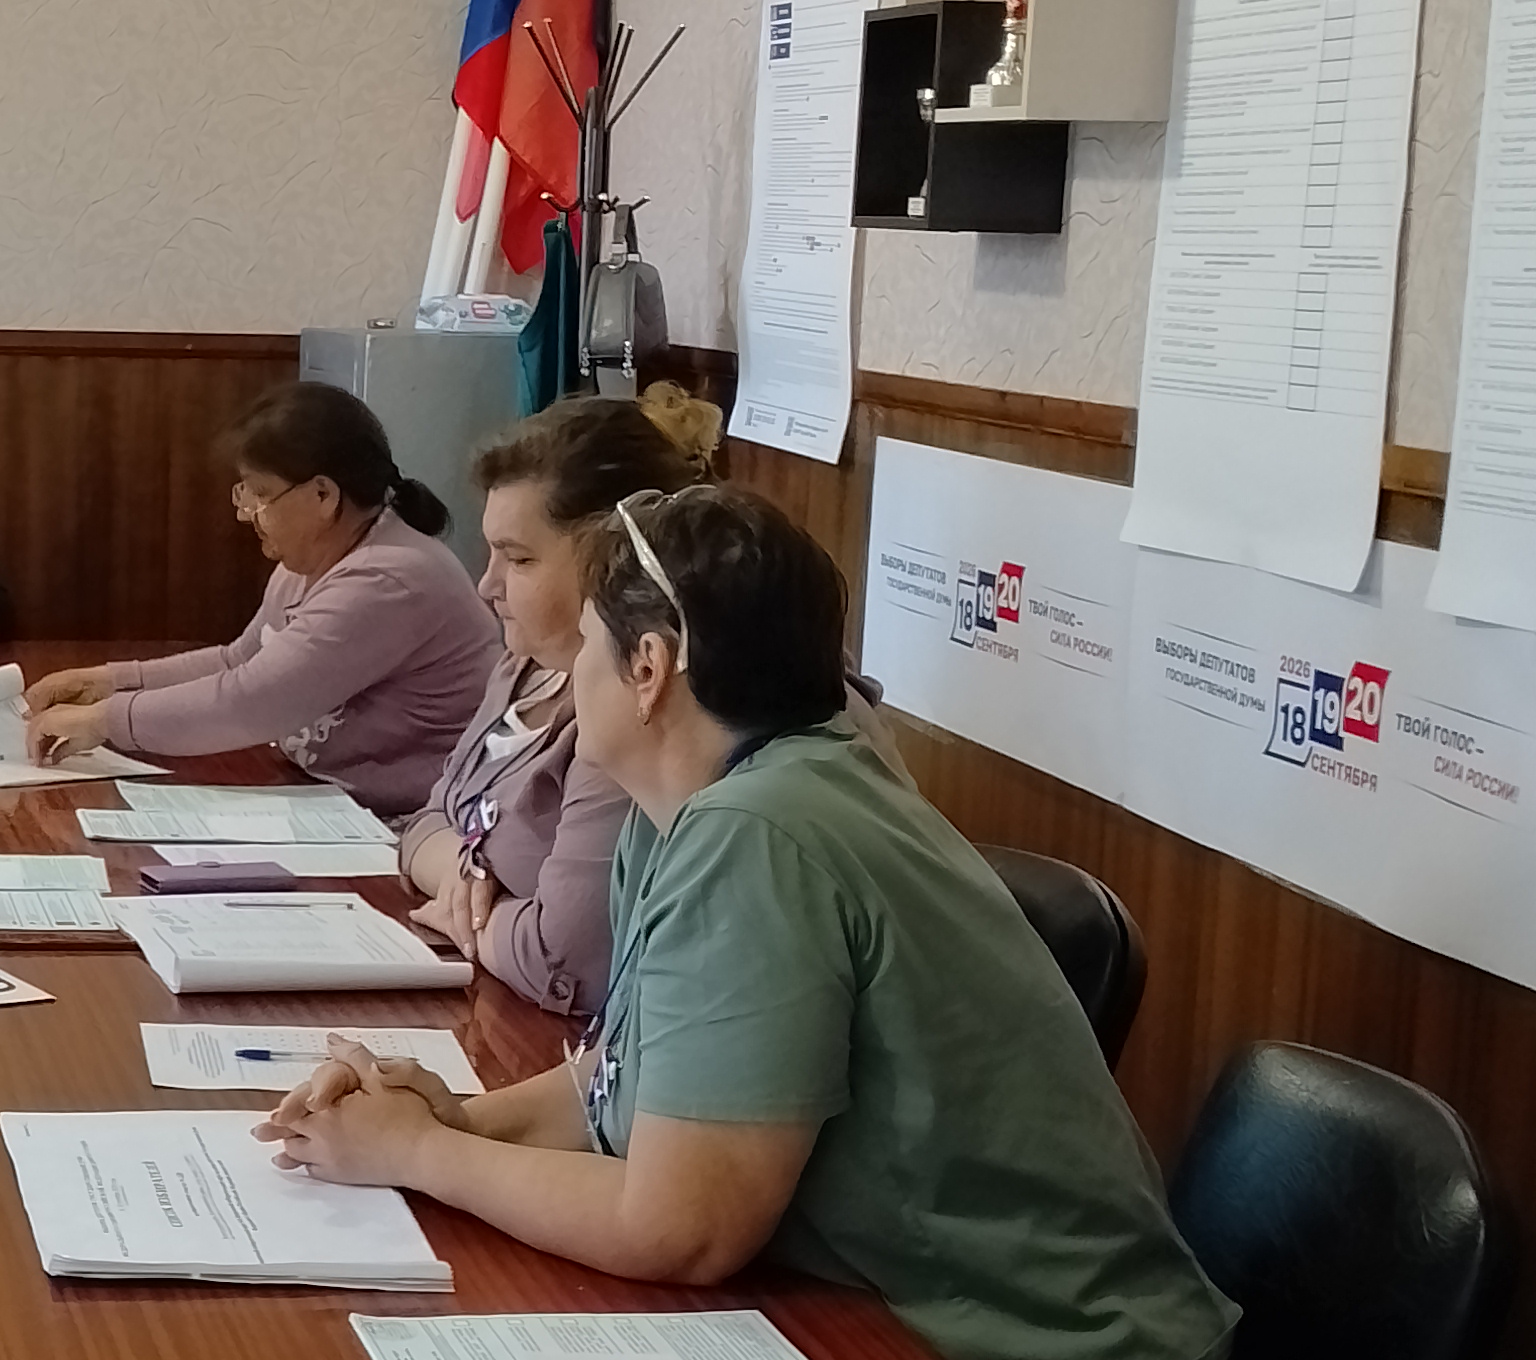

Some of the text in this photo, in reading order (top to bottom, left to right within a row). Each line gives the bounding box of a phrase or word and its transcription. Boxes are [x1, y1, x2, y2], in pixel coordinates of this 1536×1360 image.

[958, 572, 1021, 632] 18 19 20
[1028, 598, 1049, 619] ТВОЙ
[1049, 606, 1077, 628] ГОЛОС
[975, 635, 1020, 663] СЕНТЯБРЯ
[1050, 629, 1073, 649] СИЛА
[1155, 637, 1256, 684] ВЫБОРЫ ДЕПУТАТОВ
[1279, 654, 1312, 679] 2026
[1279, 675, 1381, 746] 18 19 20
[1395, 713, 1431, 740] ТВОЙ
[1433, 725, 1475, 755] ГОЛОС
[1310, 753, 1378, 793] СЕНТЯБРЯ
[1433, 755, 1521, 805] СИЛА РОССИИ!
